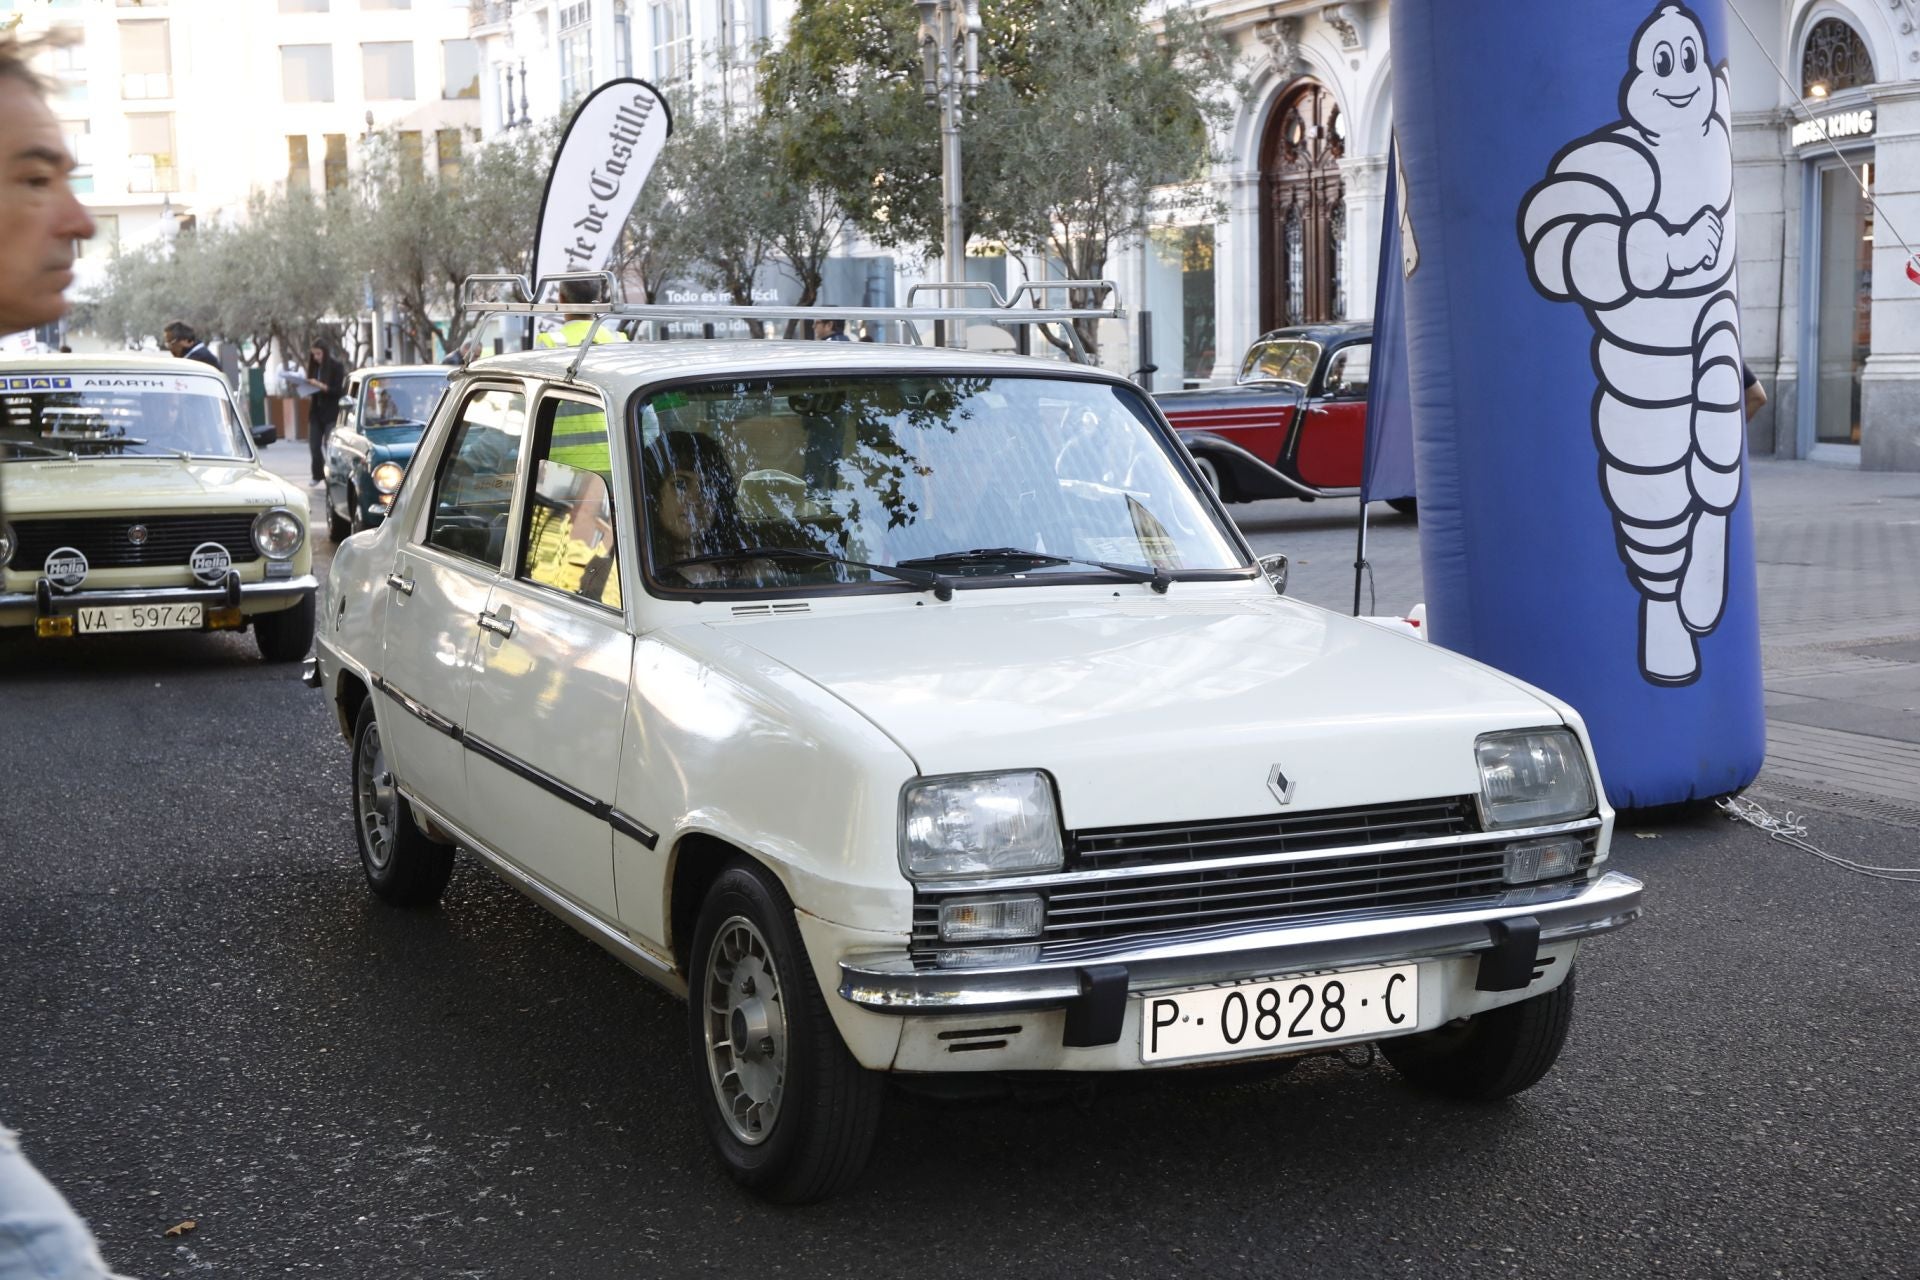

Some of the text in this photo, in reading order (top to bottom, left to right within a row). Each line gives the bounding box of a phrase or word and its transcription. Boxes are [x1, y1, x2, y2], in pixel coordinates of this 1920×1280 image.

[1828, 110, 1873, 138] KING
[589, 94, 656, 201] Castilla
[573, 203, 609, 234] de
[665, 290, 698, 303] Todo
[701, 292, 716, 302] es
[683, 319, 726, 332] mio
[84, 379, 164, 387] ABARTH
[49, 563, 85, 575] Hella
[194, 557, 228, 569] Hella
